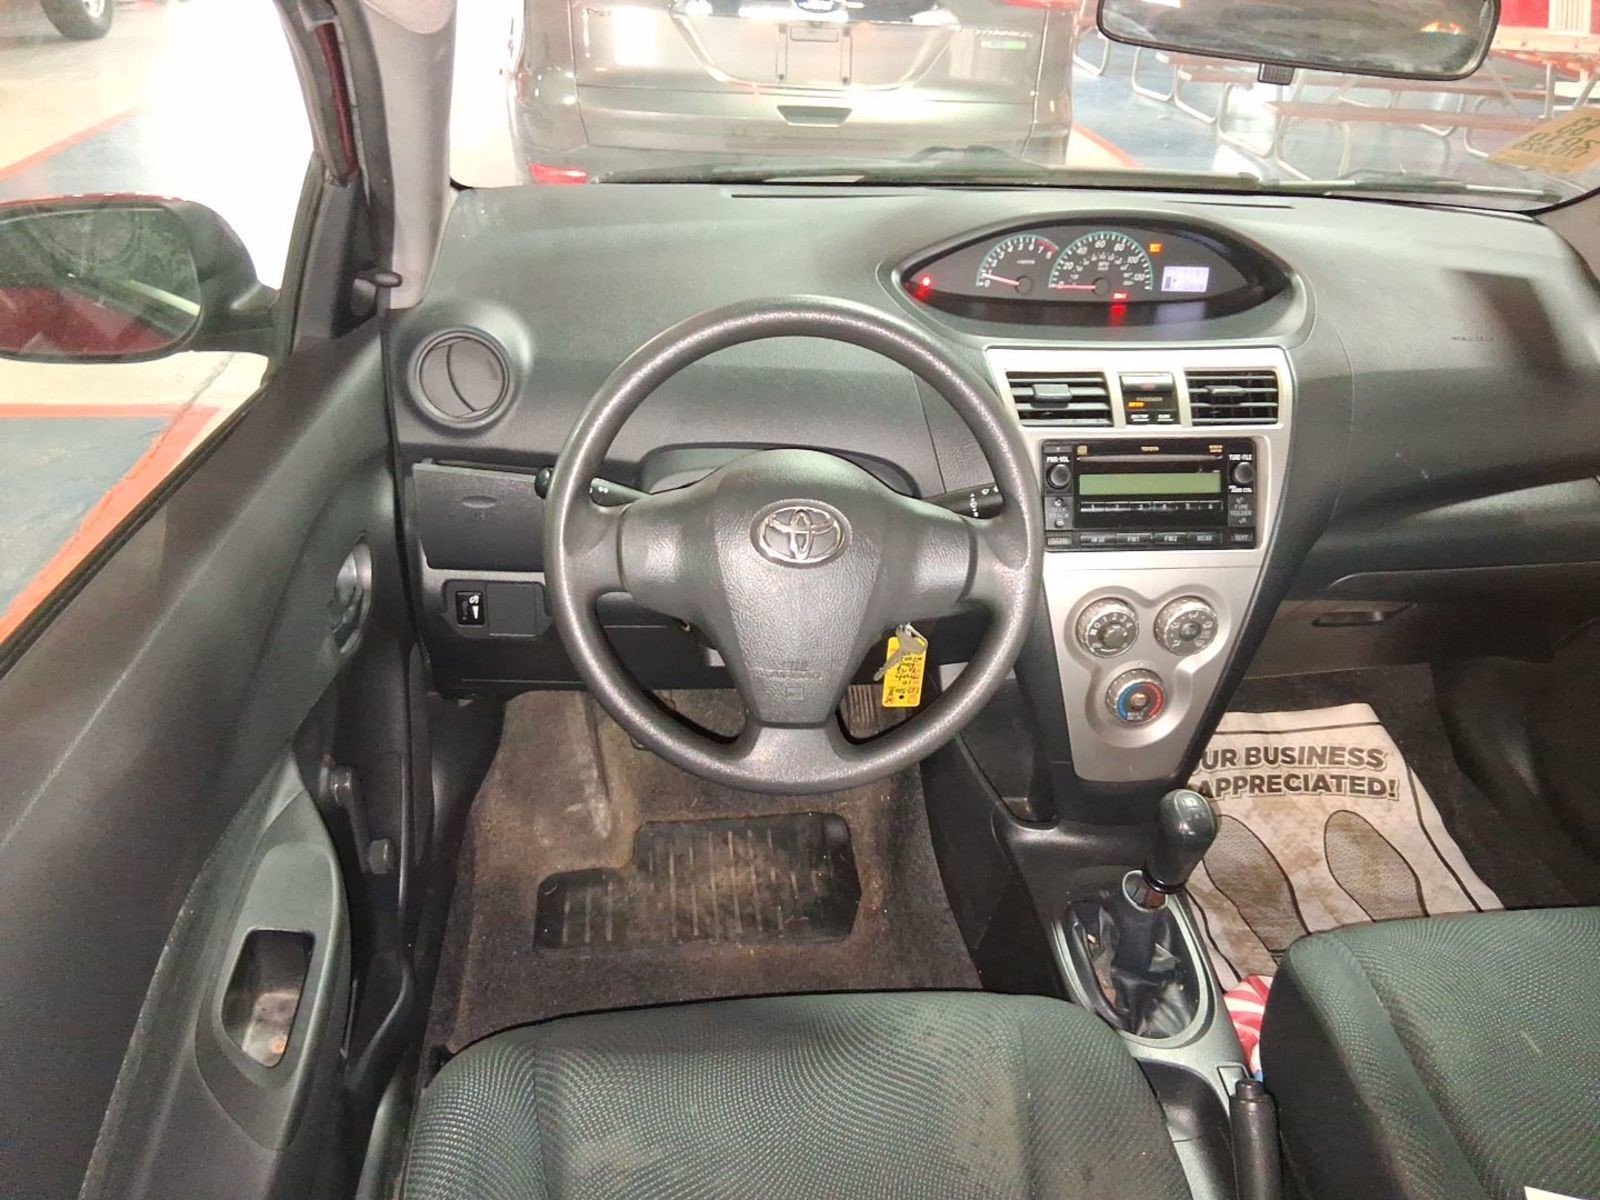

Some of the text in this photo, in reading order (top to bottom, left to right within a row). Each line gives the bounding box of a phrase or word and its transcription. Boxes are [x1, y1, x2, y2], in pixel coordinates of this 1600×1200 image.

[1095, 240, 1106, 248] 60
[1114, 243, 1125, 251] 80
[1127, 256, 1139, 264] 100
[1063, 261, 1074, 270] 20
[984, 279, 991, 288] 0
[1112, 613, 1117, 621] 2
[1120, 615, 1127, 623] 3
[1244, 746, 1384, 768] BUSINESS
[1199, 774, 1397, 798] APPRECIATED!
